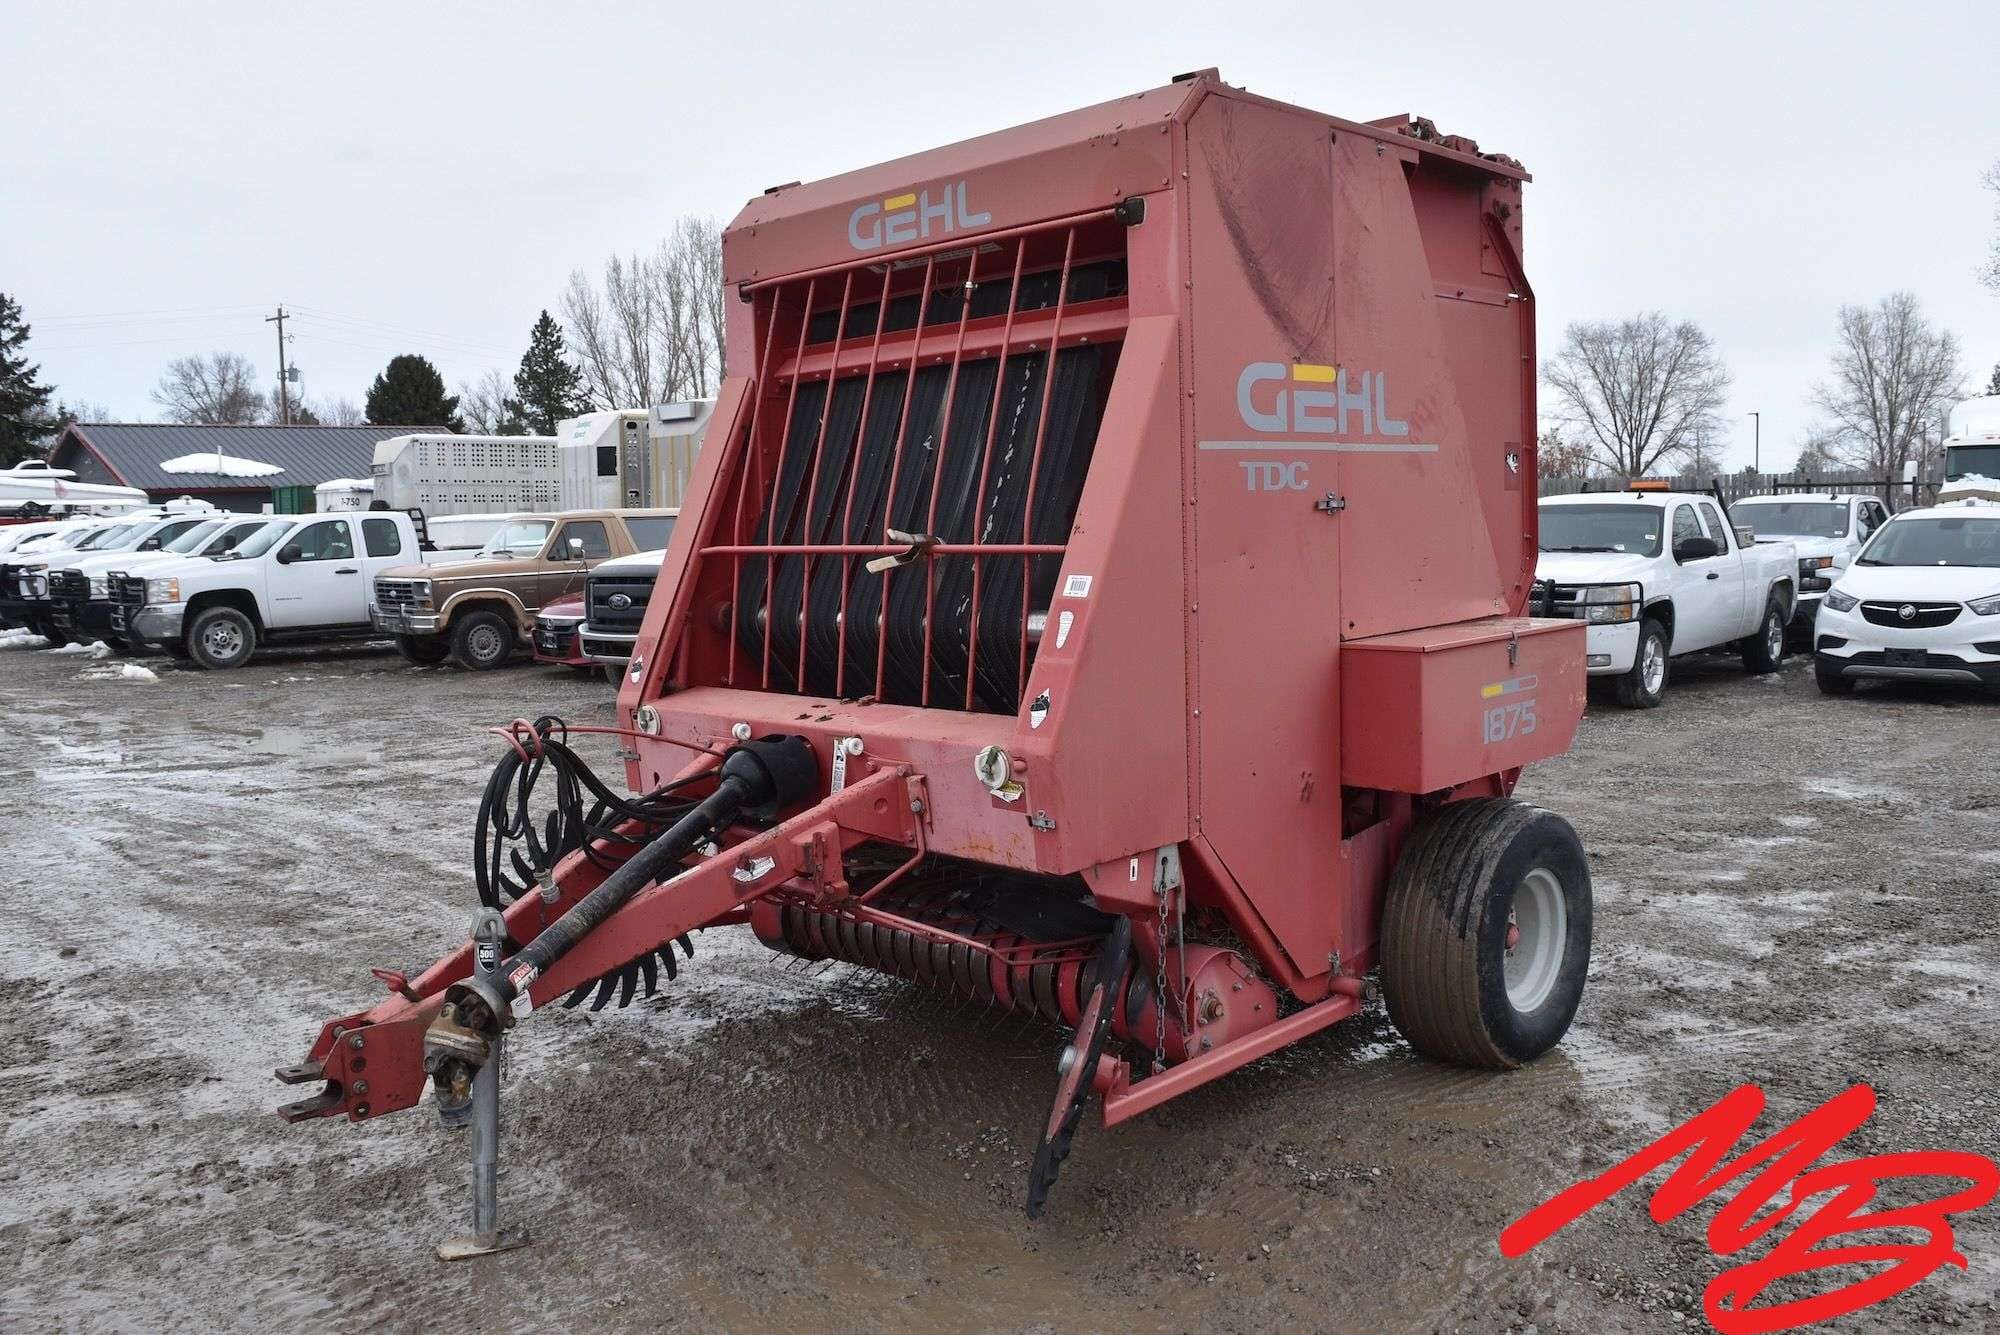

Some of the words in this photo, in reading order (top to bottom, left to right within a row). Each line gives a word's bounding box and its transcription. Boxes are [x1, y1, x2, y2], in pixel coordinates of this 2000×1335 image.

[849, 181, 991, 250] GEHL
[1238, 362, 1408, 435] GEHL
[1240, 461, 1309, 490] TDC
[1483, 699, 1537, 744] 1875
